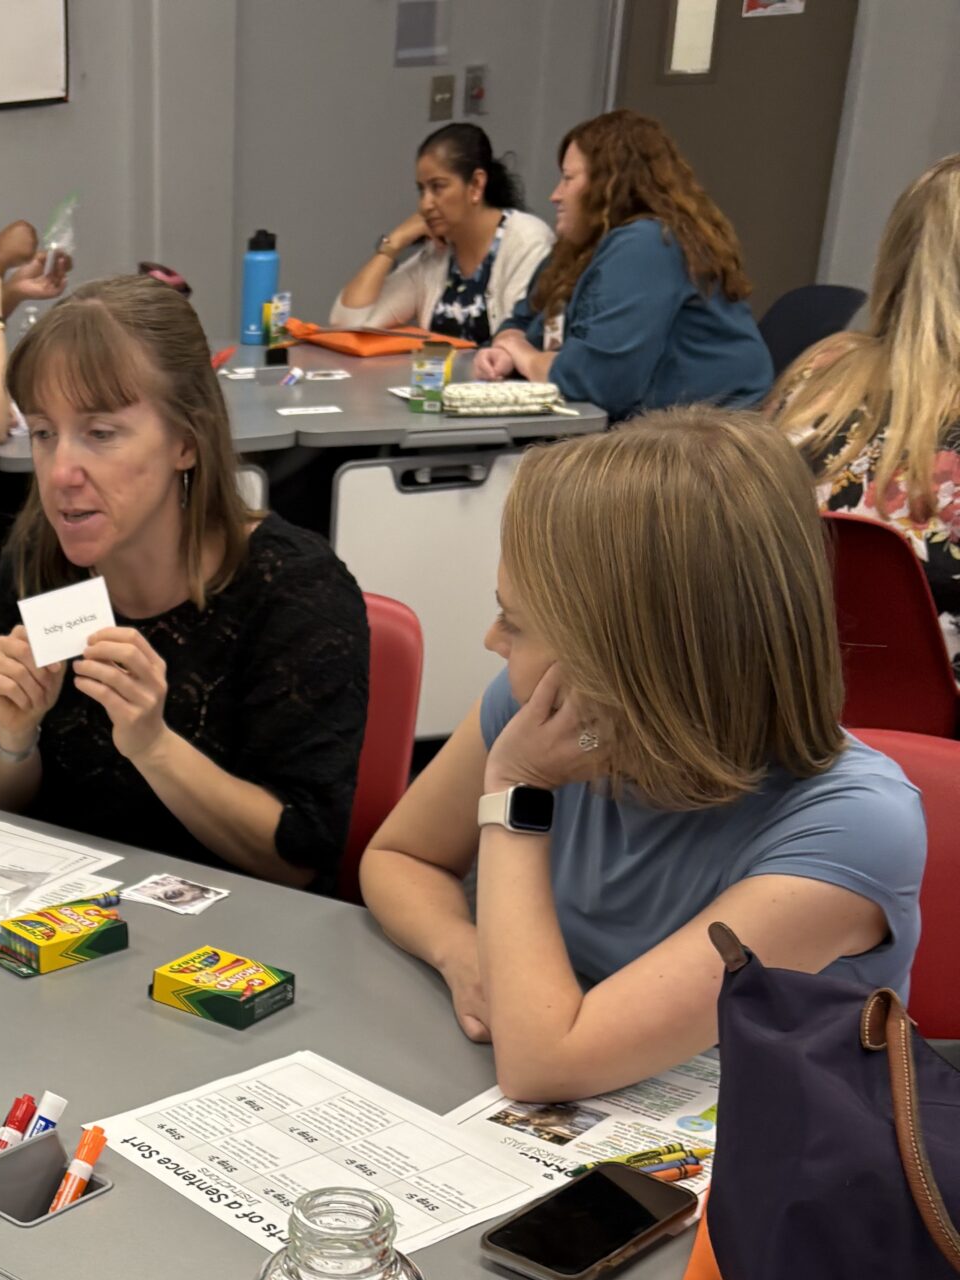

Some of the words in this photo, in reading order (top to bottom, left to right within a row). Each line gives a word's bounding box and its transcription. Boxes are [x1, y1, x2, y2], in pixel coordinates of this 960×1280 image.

[44, 623, 64, 635] baby
[65, 613, 97, 629] quokkas
[11, 921, 44, 940] Crayola
[169, 950, 214, 971] Crayola
[216, 965, 264, 989] CRAYONS
[166, 1127, 185, 1141] Step
[120, 1136, 160, 1159] Sort
[219, 1159, 238, 1173] Step
[355, 1163, 377, 1177] Step
[157, 1156, 228, 1204] Sentence
[197, 1167, 262, 1206] Instructions
[225, 1202, 243, 1210] a
[417, 1197, 440, 1212] Step
[235, 1211, 263, 1224] of
